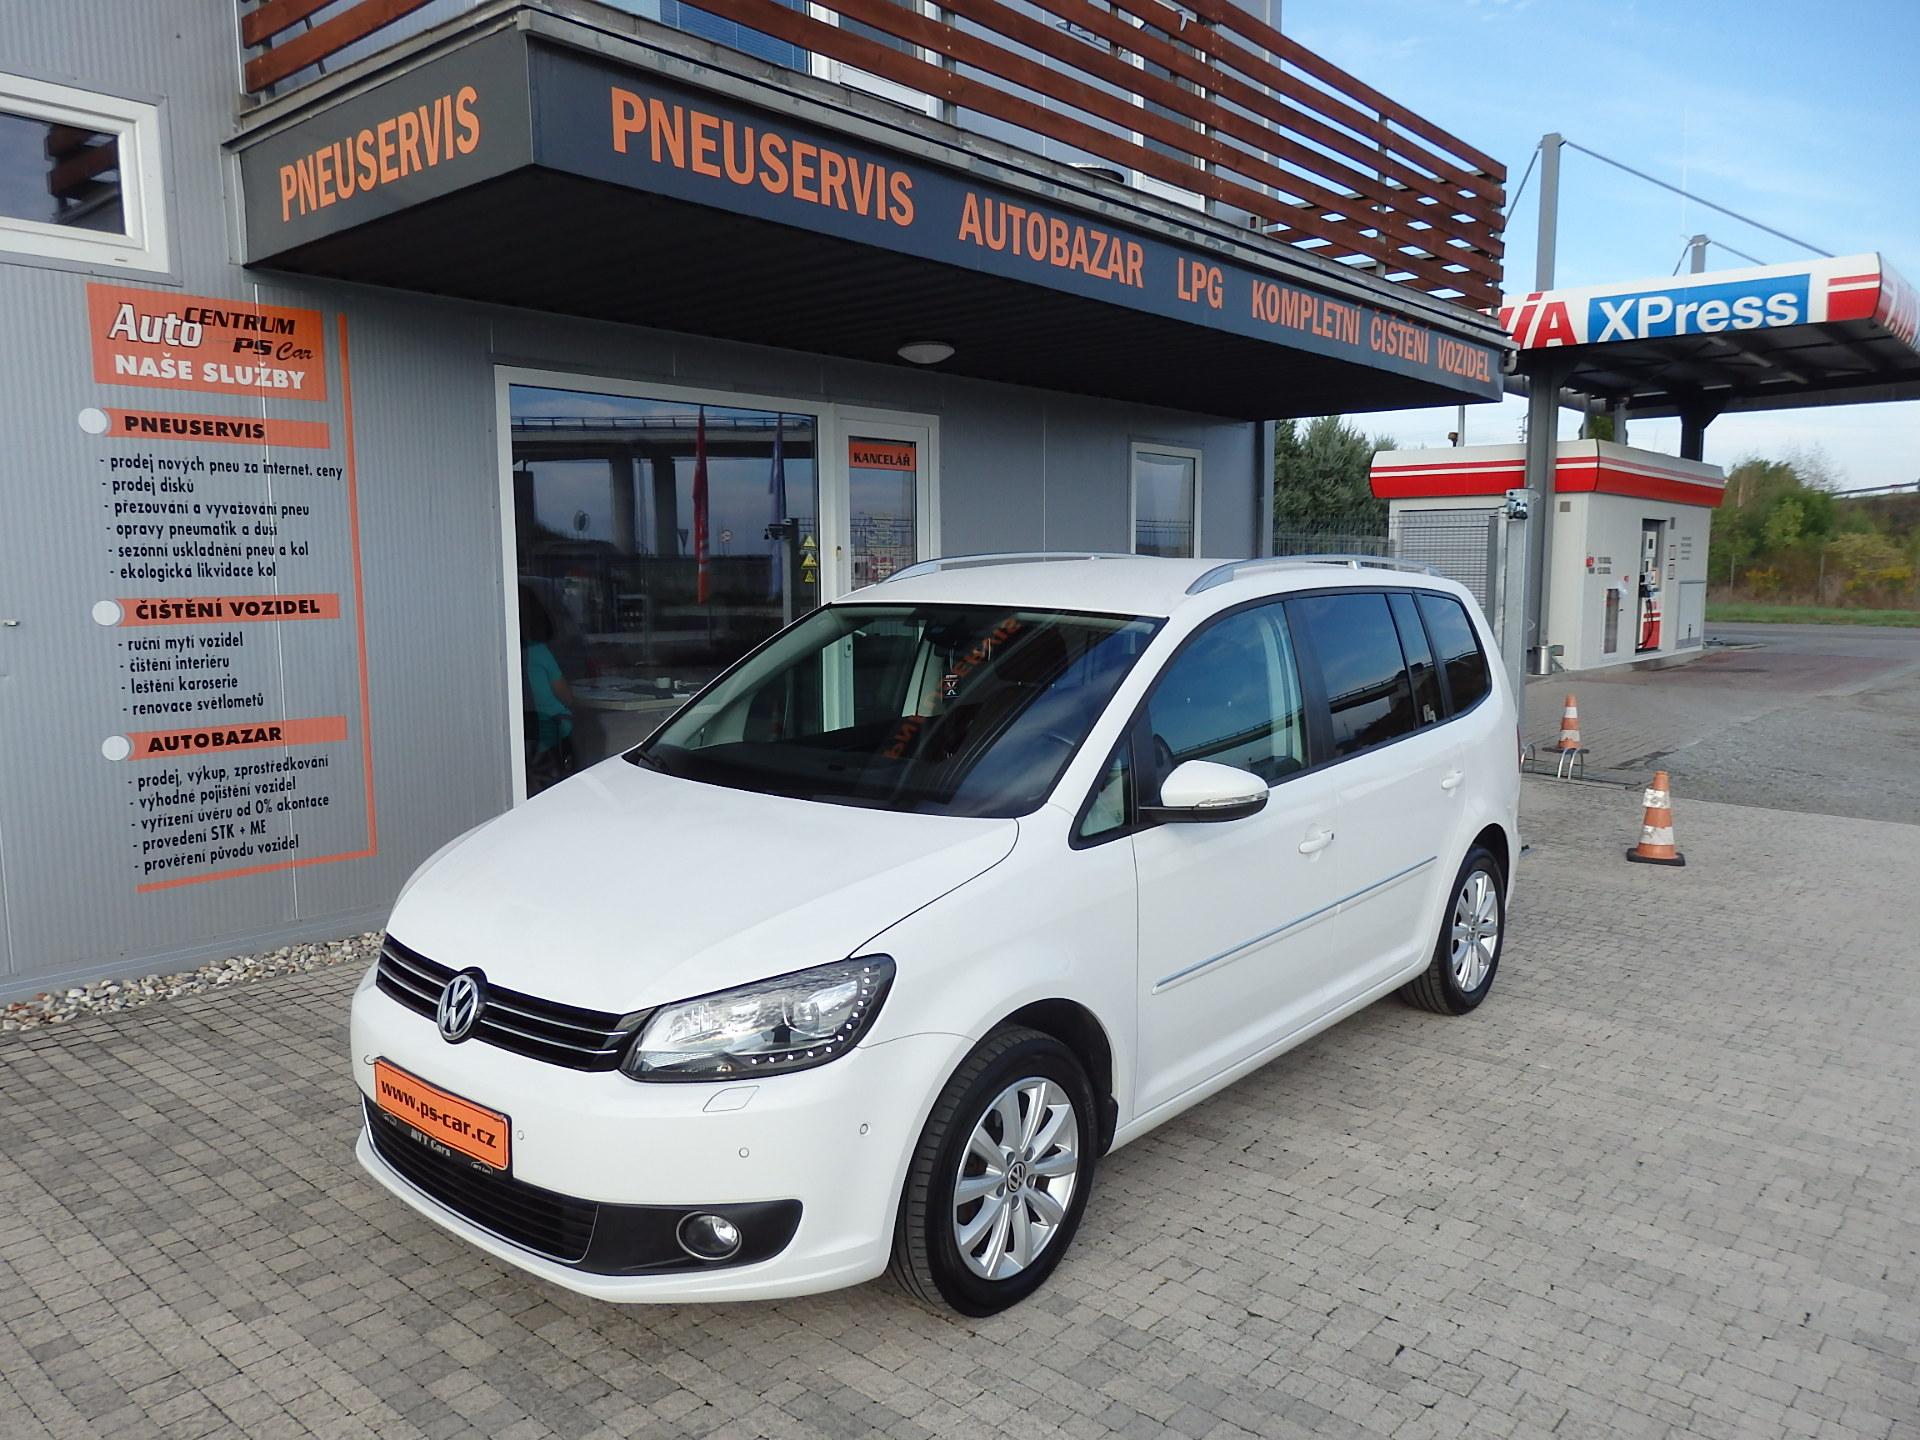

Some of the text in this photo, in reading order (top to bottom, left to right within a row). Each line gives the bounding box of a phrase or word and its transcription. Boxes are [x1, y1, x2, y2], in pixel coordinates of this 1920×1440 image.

[280, 86, 480, 222] PNEUSERVIS
[611, 86, 914, 227] PNEUSERVIS
[958, 192, 1144, 289] AUTOBAZAR
[1177, 257, 1223, 309] LPG
[108, 302, 295, 348] Auto CENTRUM
[1252, 279, 1490, 382] KOMPLETNÍ ČIŠTĚNÍ VOZIDEL
[1598, 292, 1799, 343] XPress
[233, 337, 313, 361] PS Car
[115, 352, 304, 389] NAŠE SLUŽBY
[125, 416, 265, 439] PNEUSERVIS
[110, 454, 153, 472] prodej
[158, 456, 204, 473] nových
[210, 461, 239, 475] pneu
[244, 462, 259, 473] za
[316, 465, 342, 480] ceny
[853, 451, 911, 467] KANCELÁŘ
[112, 476, 194, 495] prodej disků
[114, 500, 309, 518] přezouvání a vyvažování pneu
[117, 523, 163, 539] opravy
[169, 521, 236, 538] pneumatik
[242, 525, 249, 536] a
[118, 541, 308, 558] sezónní uskladnění pneu a kol
[121, 562, 276, 582] ekologická likvidace kol
[136, 598, 320, 620] ČIŠTĚNÍ VOZIDEL
[128, 632, 243, 652] ruční mytí vozidel
[130, 655, 229, 673] čištění interiéru
[131, 674, 238, 694] leštění karoserie
[133, 693, 264, 715] renovace světlometů
[148, 727, 282, 752] AUTOBAZAR
[138, 755, 329, 791] prodej, výkup, zprostředkování
[140, 777, 296, 811] výhodné pojištění vozidel
[141, 794, 329, 833] vyřízení úvěru od 0% akontace
[143, 829, 207, 854] provedení
[211, 824, 235, 841] STK
[250, 820, 266, 834] ME
[144, 834, 299, 875] prověření původu vozidel
[381, 1081, 497, 1149] www.ps-car.cz
